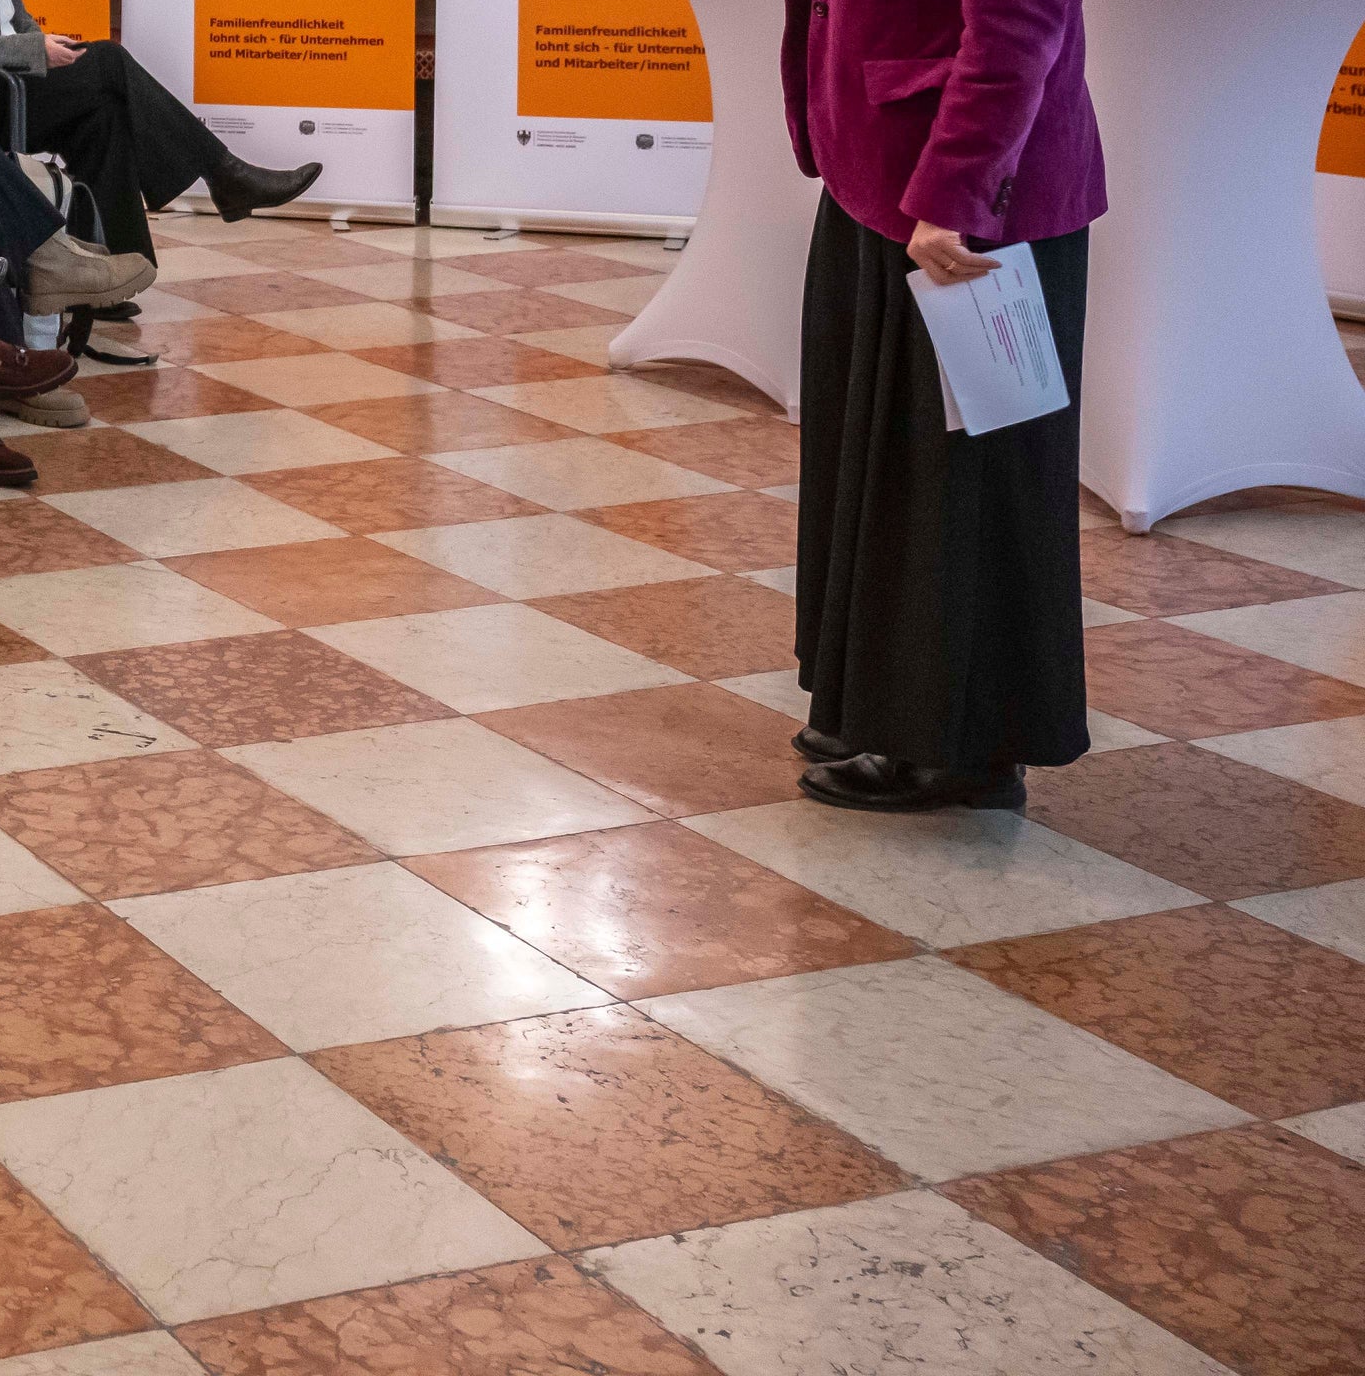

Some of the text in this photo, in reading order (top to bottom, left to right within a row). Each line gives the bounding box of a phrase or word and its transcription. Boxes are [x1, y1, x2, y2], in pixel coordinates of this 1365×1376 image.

[209, 18, 345, 30] Familienfreundlichkeit
[536, 25, 687, 38] Familienfreundlichkeit
[209, 33, 384, 46] lohnt sich für Unternehmen
[536, 41, 569, 52] lohnt
[573, 41, 599, 52] sich
[614, 43, 634, 53] für
[209, 49, 347, 61] und Mitarbeiter/innen!
[535, 58, 690, 72] und Mitarbeiter/innen!
